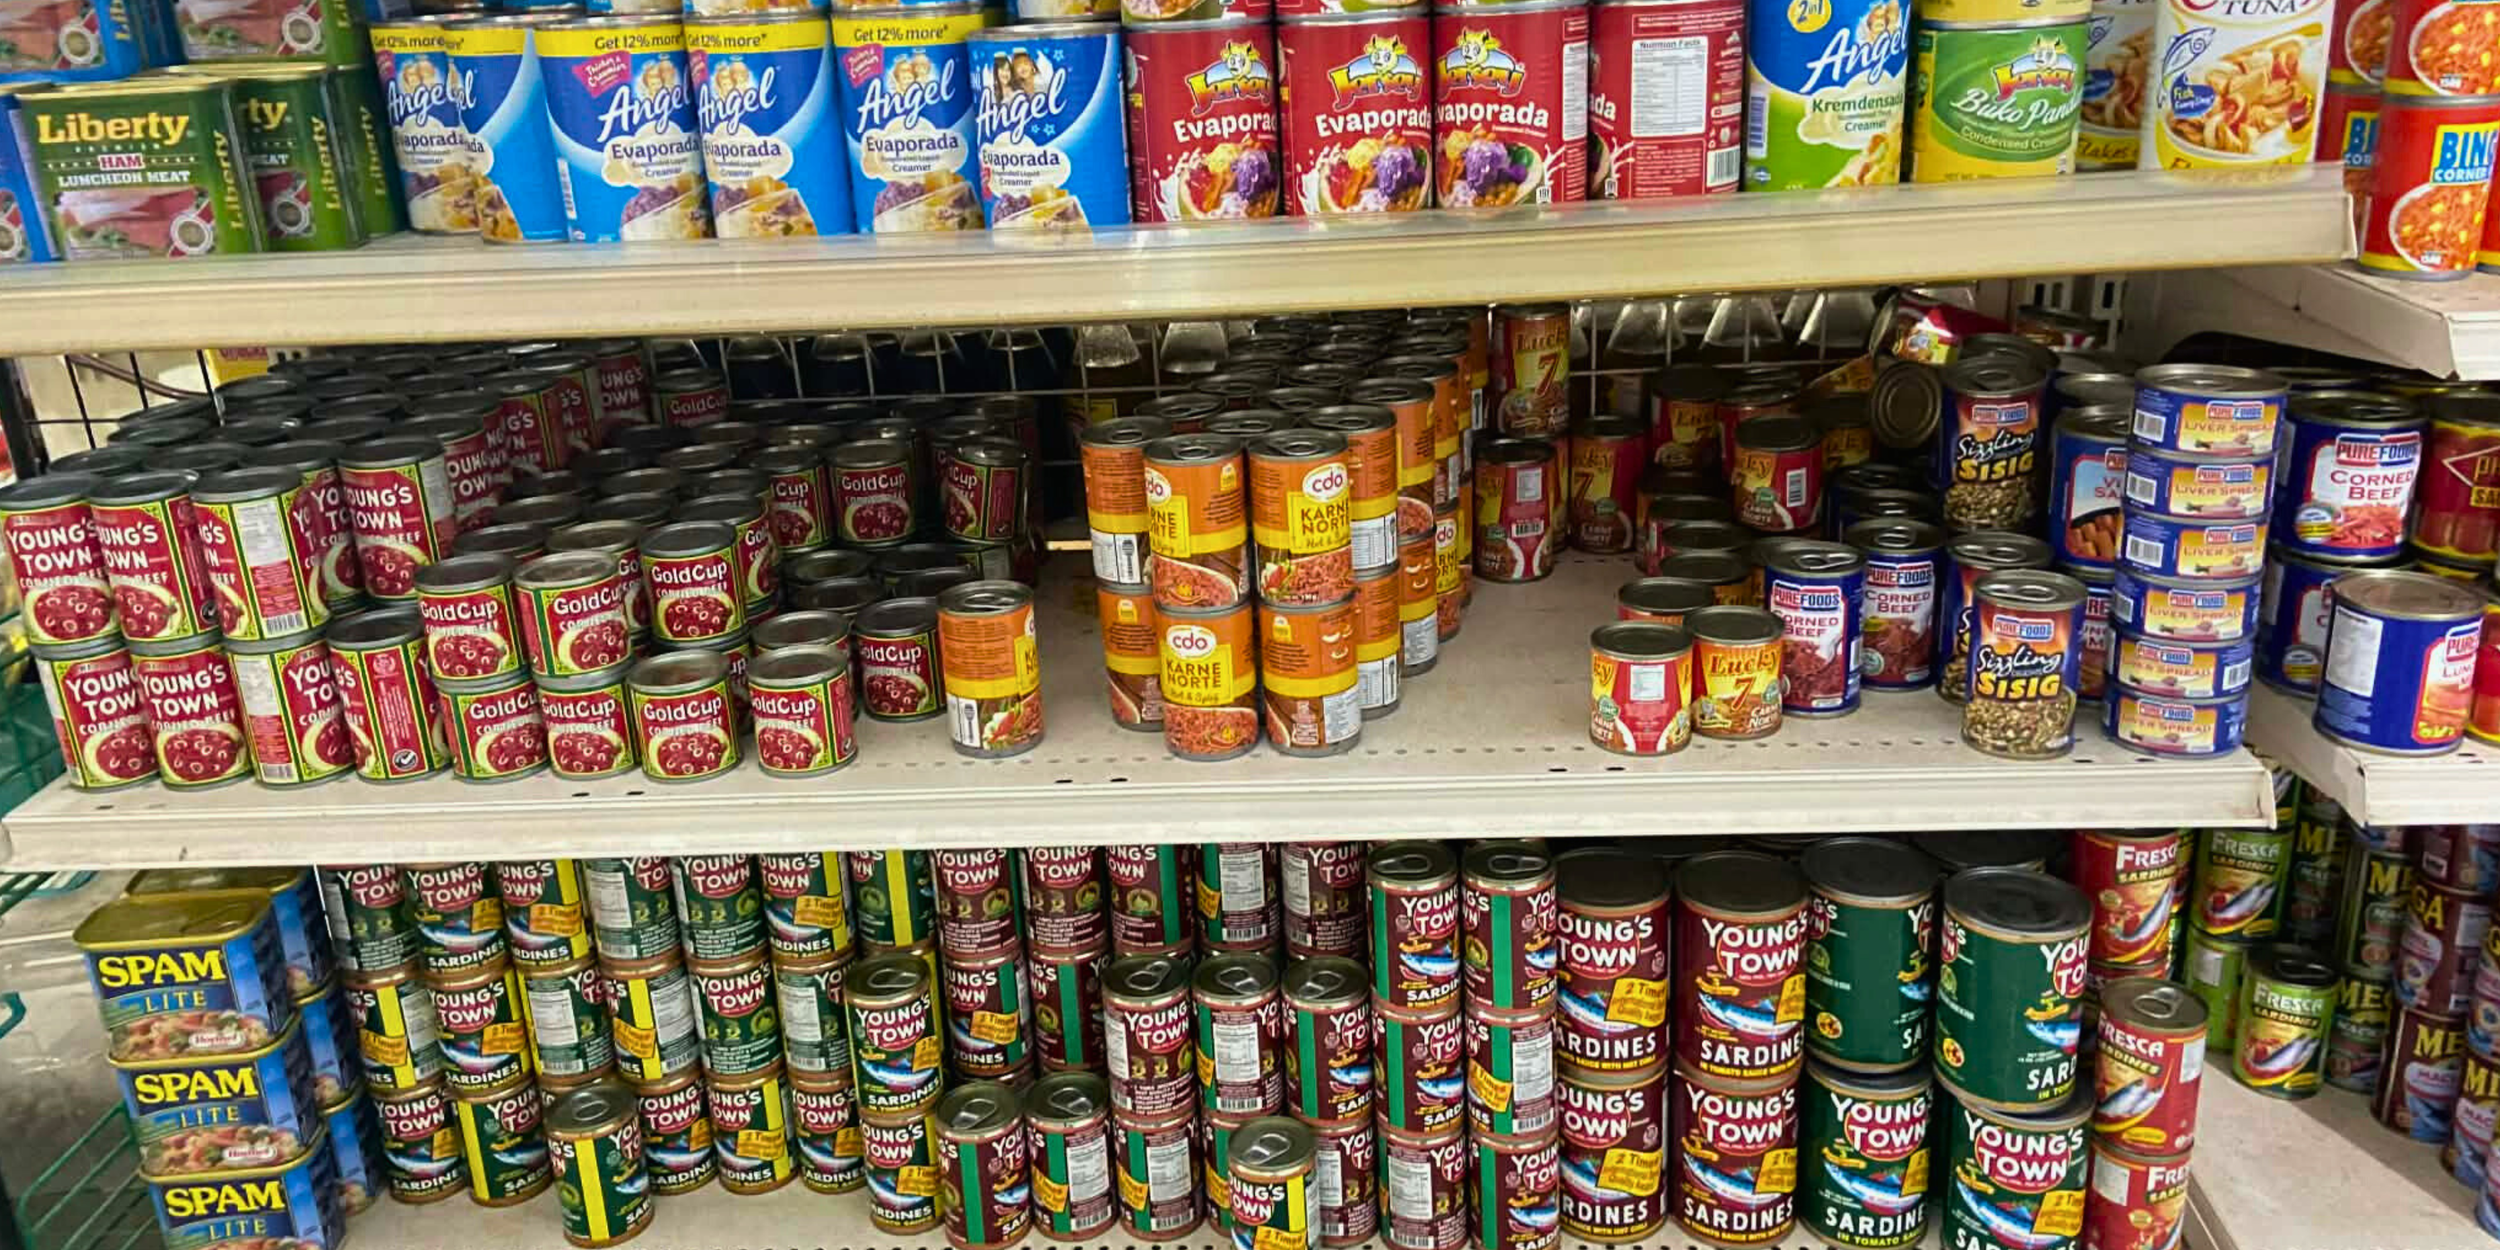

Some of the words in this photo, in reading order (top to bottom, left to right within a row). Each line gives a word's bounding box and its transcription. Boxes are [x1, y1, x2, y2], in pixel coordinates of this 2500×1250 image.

[2224, 0, 2296, 15] TUNA
[595, 37, 619, 50] Get
[623, 35, 649, 47] 12%
[724, 34, 766, 47] more
[854, 28, 874, 43] Get
[877, 27, 902, 41] 12%
[906, 26, 948, 39] more
[1799, 2, 1910, 93] Angel
[388, 81, 456, 127] Angel
[597, 64, 690, 142] Angel
[698, 66, 777, 134] Angel
[857, 58, 956, 133] Angel
[976, 68, 1067, 146] Angel
[1950, 88, 2022, 122] Buko
[36, 112, 189, 145] Liberty
[1316, 108, 1431, 137] Evaporada
[612, 140, 699, 162] Evaporada
[866, 135, 958, 153] Evaporada
[101, 156, 142, 168] HAM
[893, 162, 931, 173] Creamer
[982, 151, 1059, 169] Evaporada
[57, 171, 142, 187] LUNCHEON
[148, 171, 190, 183] MEAT
[1537, 352, 1559, 396] 7
[1958, 430, 2034, 462] Sizzling
[1959, 453, 2034, 480] SISIG
[2331, 470, 2414, 484] CORNED
[842, 472, 906, 490] GoldCup
[1312, 471, 1344, 493] cdo
[2349, 486, 2402, 500] BEEF
[6, 517, 99, 553] YOUNG'S
[20, 546, 92, 575] TOWN
[651, 560, 728, 584] GoldCup
[1868, 568, 1933, 584] PUREFOODS
[1774, 588, 1839, 606] PUREFOODS
[1865, 590, 1930, 601] CORNED
[1878, 602, 1919, 613] BEEF
[421, 600, 498, 622] GoldCup
[1172, 633, 1208, 649] cdo
[1167, 661, 1221, 675] KARNE
[1977, 646, 2062, 676] Sizzling
[140, 663, 227, 697] YOUNG'S
[1167, 674, 1221, 689] NORTE
[1732, 676, 1757, 710] 7
[1977, 674, 2060, 699] SISIG
[151, 692, 219, 719] TOWN
[542, 699, 615, 718] GoldCup
[644, 696, 722, 721] GoldCup
[693, 868, 750, 893] TOWN
[944, 869, 1000, 886] TOWN
[1036, 861, 1091, 881] TOWN
[422, 881, 484, 907] TOWN
[1702, 912, 1808, 948] YOUNG'S
[1558, 938, 1637, 967] TOWN
[1721, 943, 1800, 977] TOWN
[98, 951, 227, 986] SPAM
[697, 963, 771, 993] YOUNG'S
[145, 990, 207, 1013] LITE
[429, 981, 505, 1003] YOUNG'S
[709, 986, 765, 1012] TOWN
[1625, 983, 1633, 995] 2
[2254, 982, 2324, 1012] FRESCA
[440, 1004, 496, 1027] TOWN
[856, 994, 930, 1026] YOUNG'S
[869, 1018, 926, 1044] TOWN
[1139, 1017, 1190, 1047] TOWN
[2100, 1012, 2164, 1058] FRESCA
[135, 1068, 258, 1103] SPAM
[868, 1079, 939, 1105] SARDINES
[1686, 1083, 1795, 1118] YOUNG'S
[180, 1107, 241, 1128] LITE
[387, 1110, 445, 1135] TOWN
[647, 1102, 700, 1129] TOWN
[799, 1110, 848, 1130] TOWN
[1702, 1117, 1783, 1143] TOWN
[1848, 1120, 1926, 1150] TOWN
[1964, 1110, 2083, 1157] YOUNG'S
[866, 1143, 913, 1159] TOWN
[1978, 1144, 2068, 1180] TOWN
[165, 1181, 285, 1216] SPAM
[1684, 1197, 1793, 1231] SARDINES
[209, 1219, 267, 1240] LITE
[1854, 1236, 1900, 1246] TOMATO
